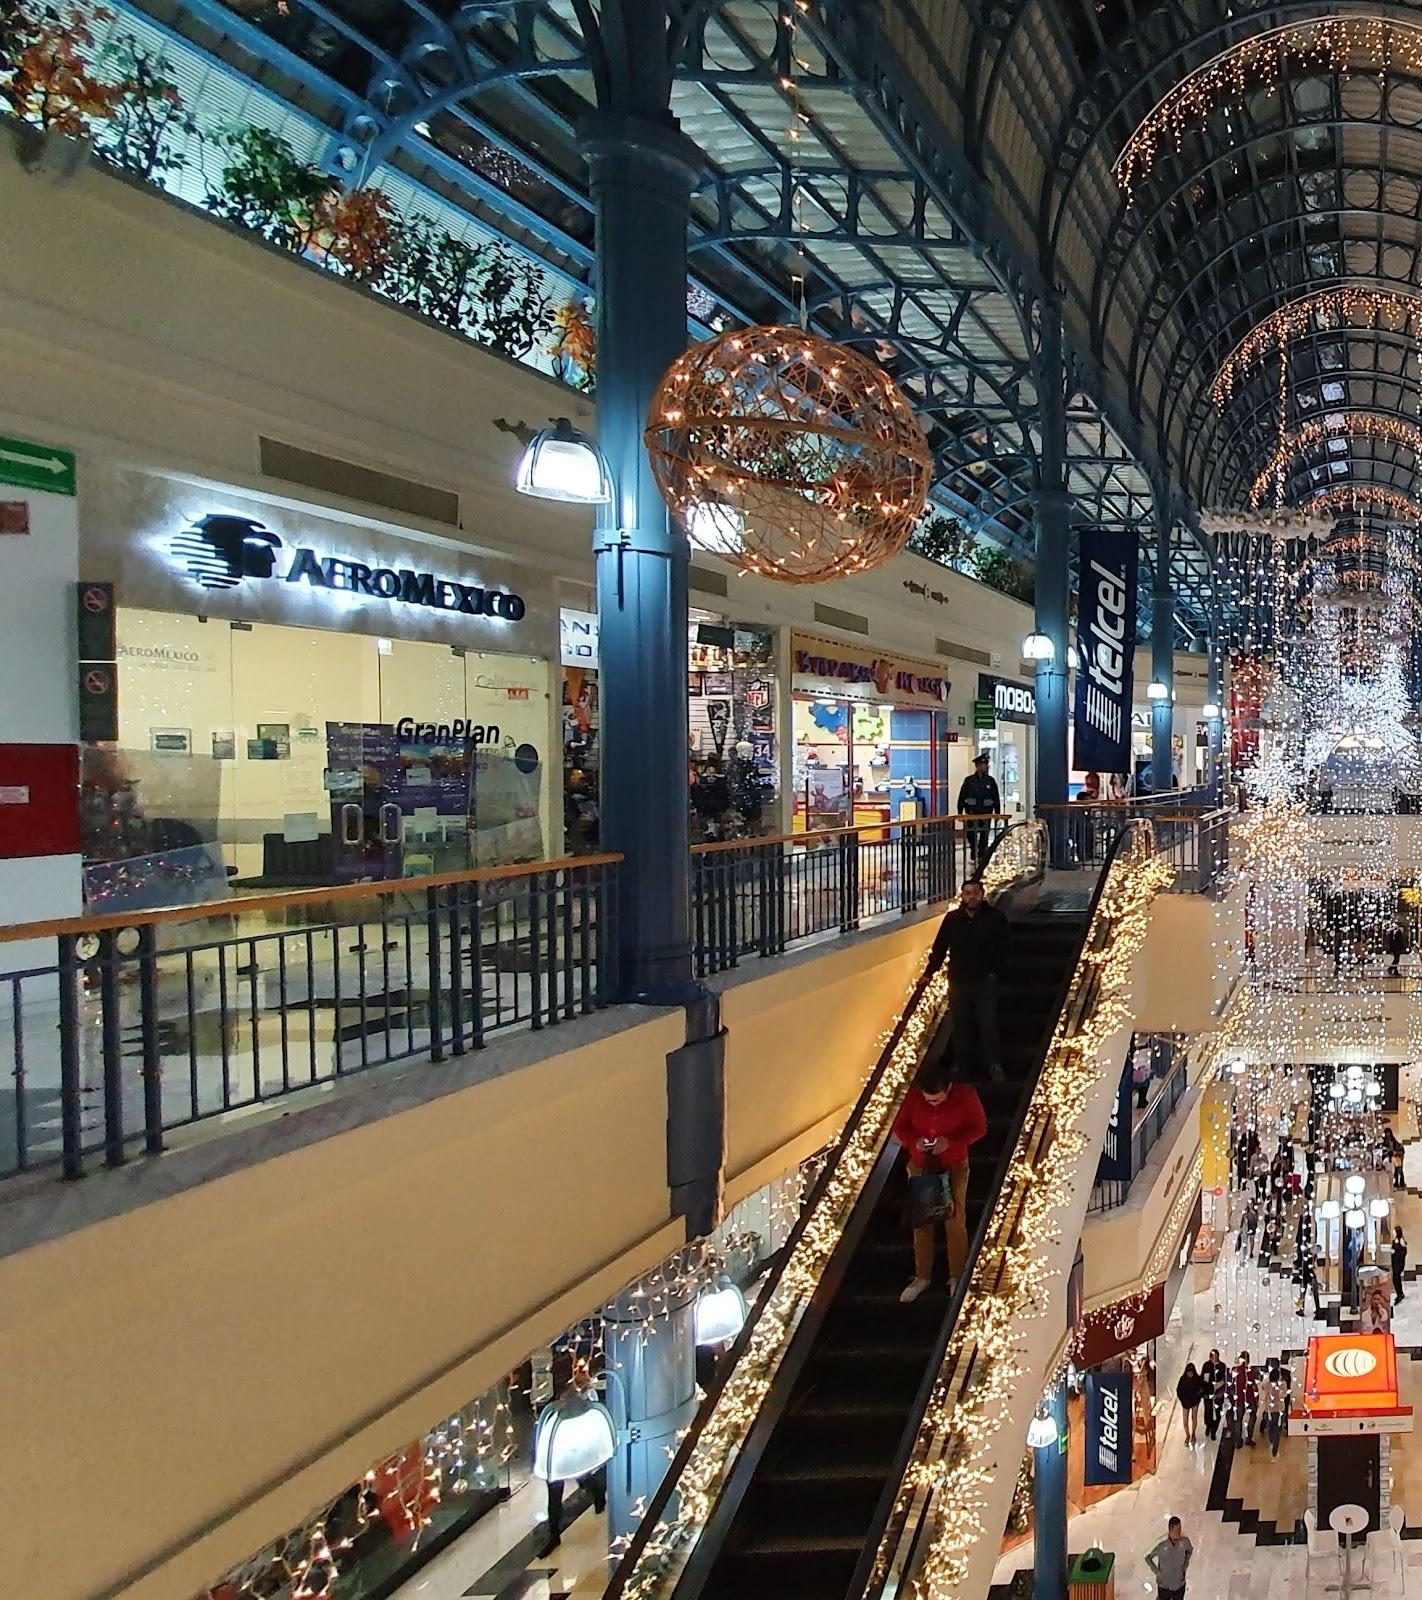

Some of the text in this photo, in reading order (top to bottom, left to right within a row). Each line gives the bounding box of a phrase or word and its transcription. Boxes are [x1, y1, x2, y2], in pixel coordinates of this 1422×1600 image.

[286, 548, 526, 621] AEROMEXICO
[1088, 560, 1126, 695] telcel
[397, 717, 500, 744] GranPlan
[1100, 1386, 1119, 1450] telcel
